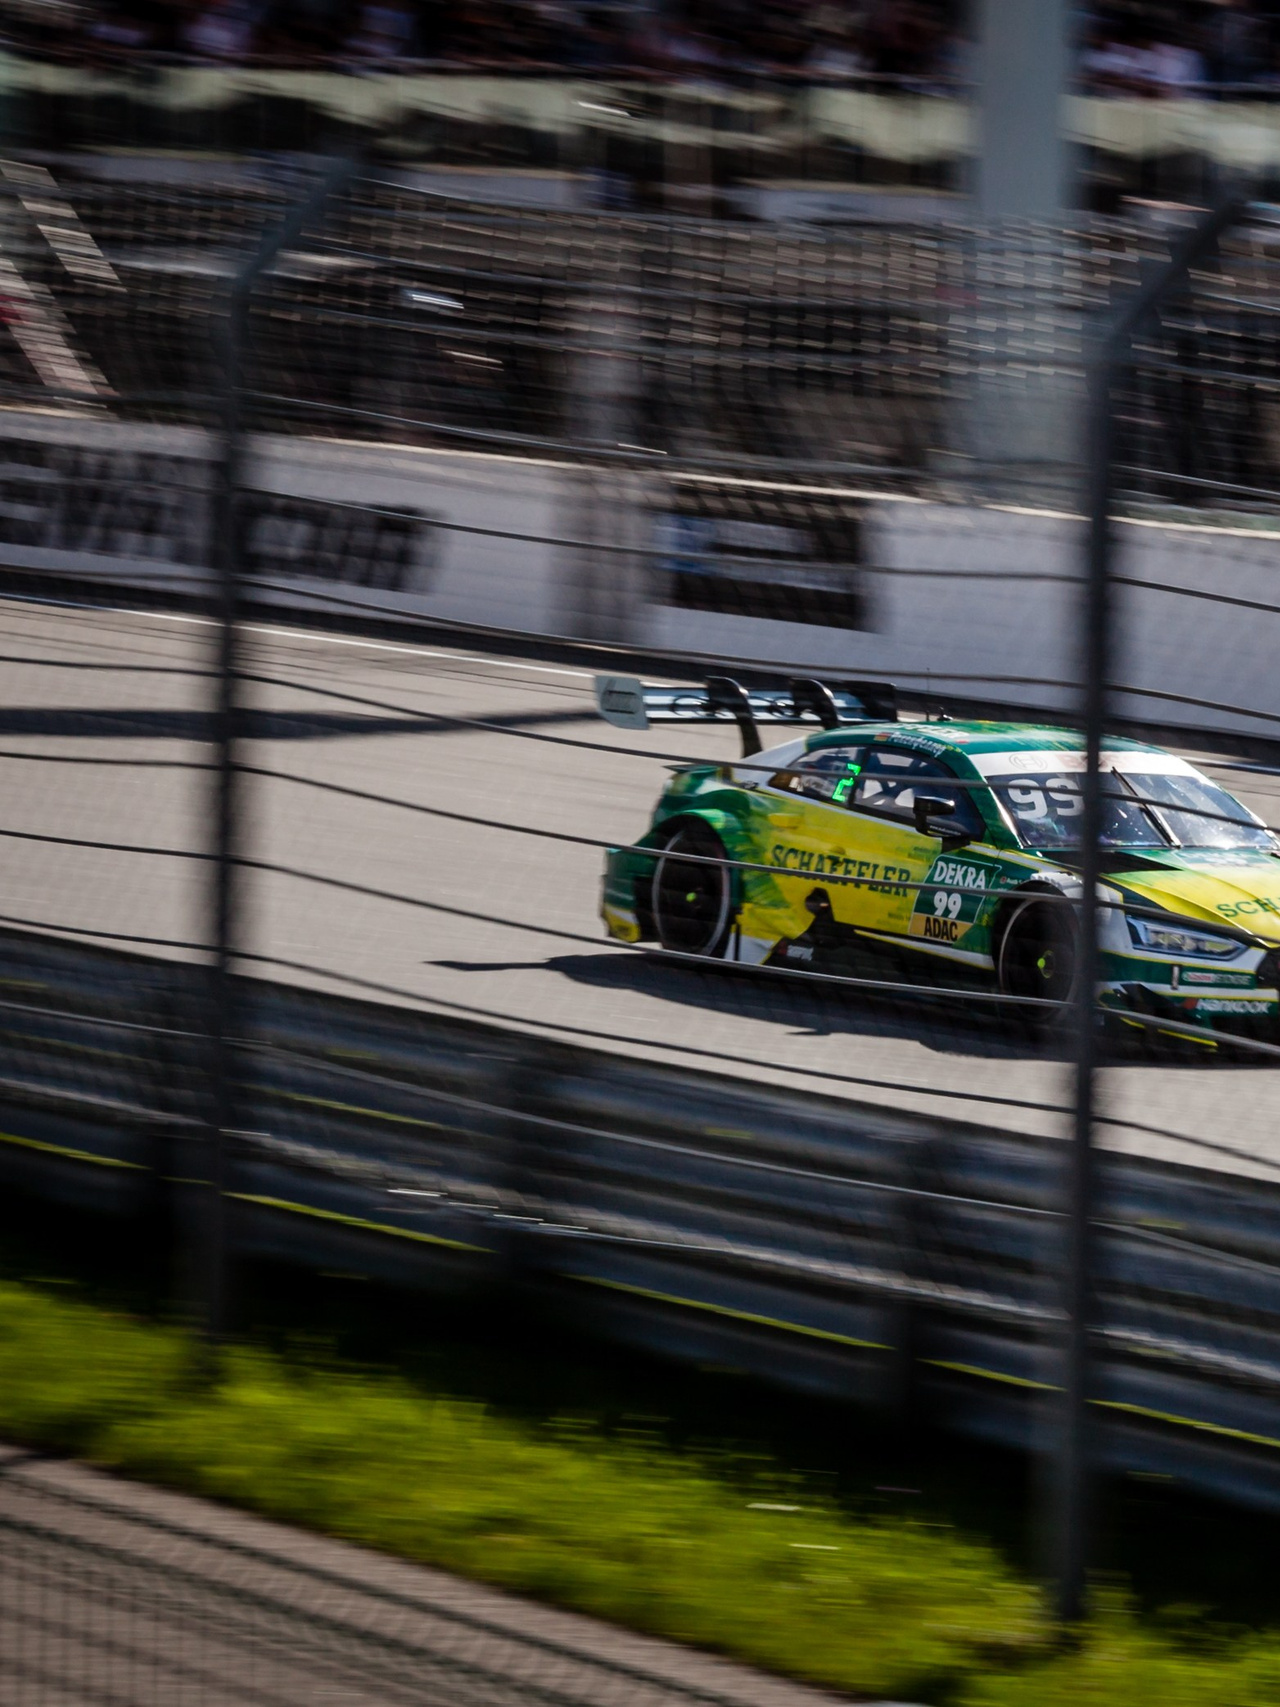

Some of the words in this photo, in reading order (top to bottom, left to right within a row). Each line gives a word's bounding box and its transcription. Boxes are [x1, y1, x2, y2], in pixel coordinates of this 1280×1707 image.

[770, 843, 912, 898] SCHAEFFLER
[932, 860, 987, 890] DEKRA
[933, 890, 962, 920] 99
[923, 916, 958, 941] ADAC
